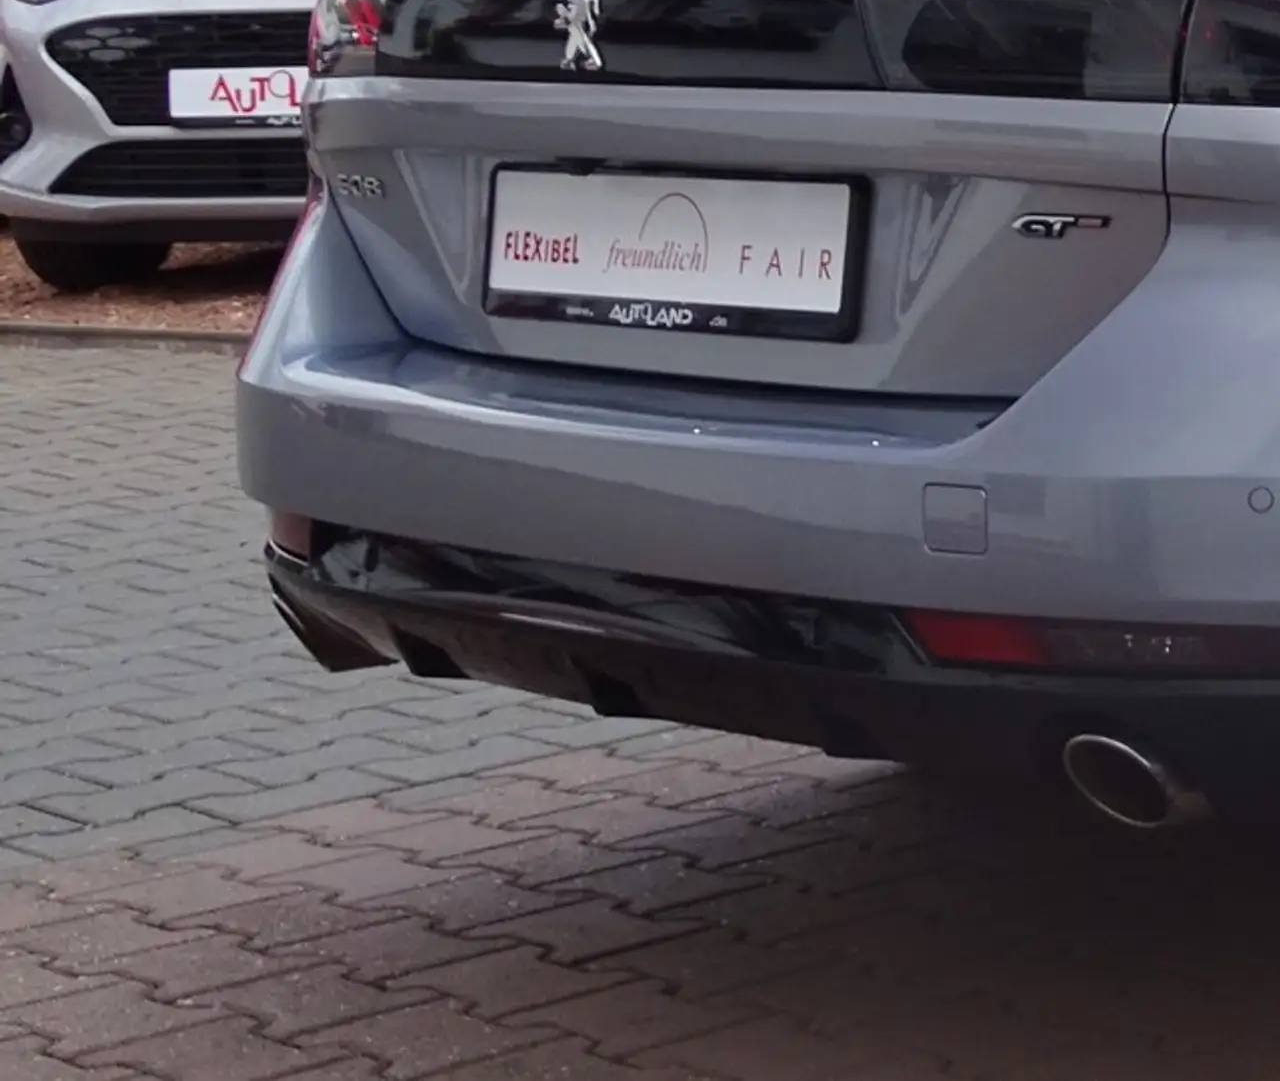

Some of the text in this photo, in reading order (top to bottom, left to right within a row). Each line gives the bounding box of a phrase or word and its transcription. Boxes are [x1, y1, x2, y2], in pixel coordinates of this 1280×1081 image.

[208, 69, 301, 113] AUTOL
[504, 231, 832, 280] FLEXIBEL freundlich FAIR
[608, 303, 693, 327] AUTOLAND
